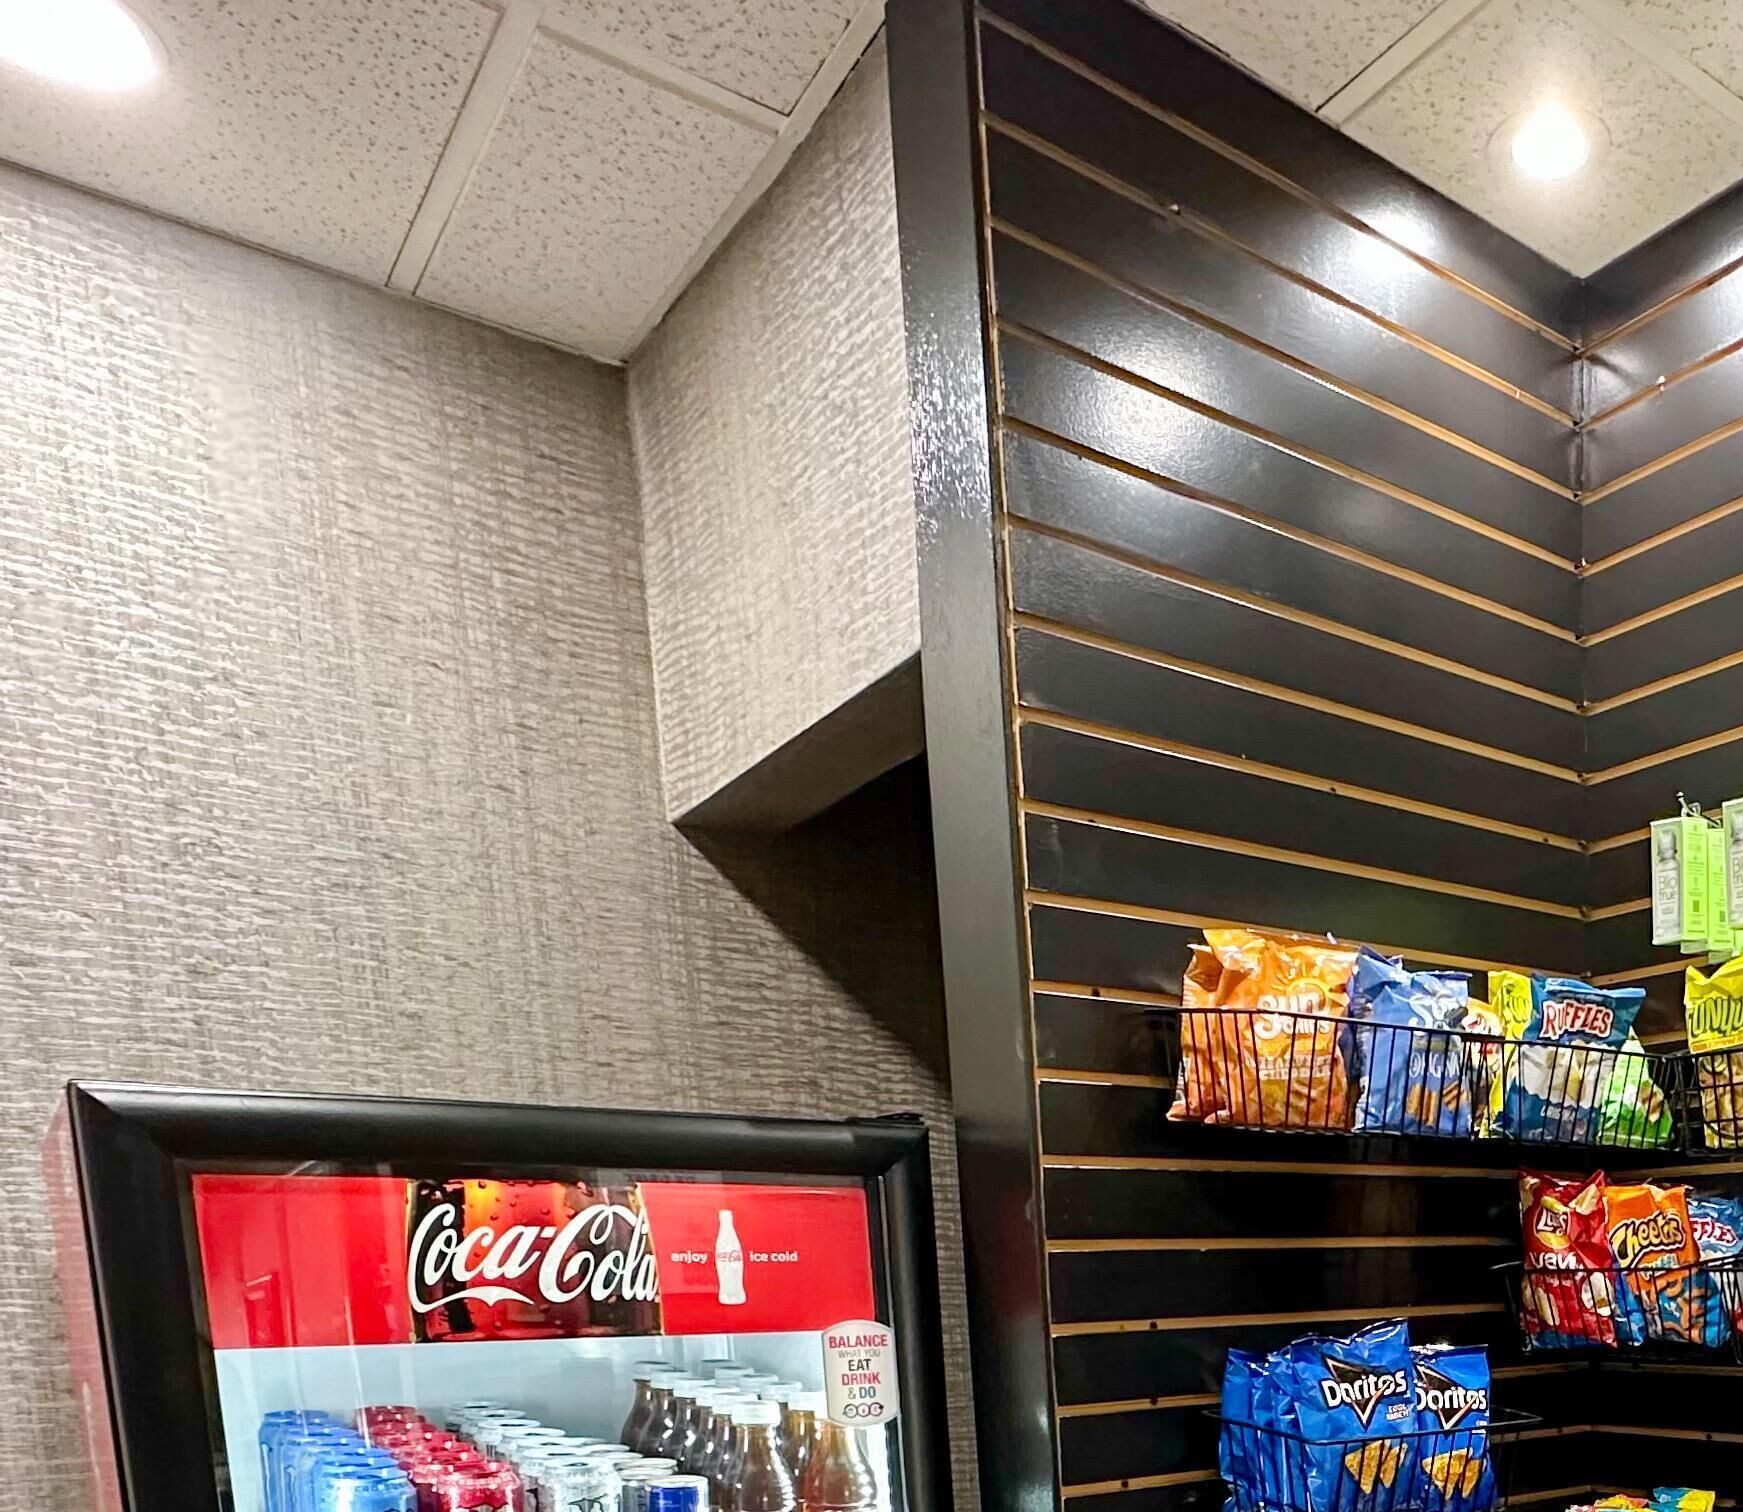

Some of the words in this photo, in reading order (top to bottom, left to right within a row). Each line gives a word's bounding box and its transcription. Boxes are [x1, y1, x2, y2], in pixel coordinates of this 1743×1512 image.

[1658, 875, 1678, 891] Bio
[1541, 1001, 1614, 1038] RUFFLES
[408, 1203, 660, 1313] Coca-Cola
[671, 1250, 707, 1264] enjoy
[750, 1250, 768, 1262] ice
[771, 1250, 798, 1262] cold
[829, 1334, 888, 1349] BALANCE
[848, 1359, 872, 1371] EAT
[841, 1372, 881, 1386] DRINK
[848, 1387, 857, 1399] &
[859, 1386, 876, 1399] DO
[1323, 1370, 1408, 1408] Doritos
[1415, 1386, 1487, 1412] Doritos
